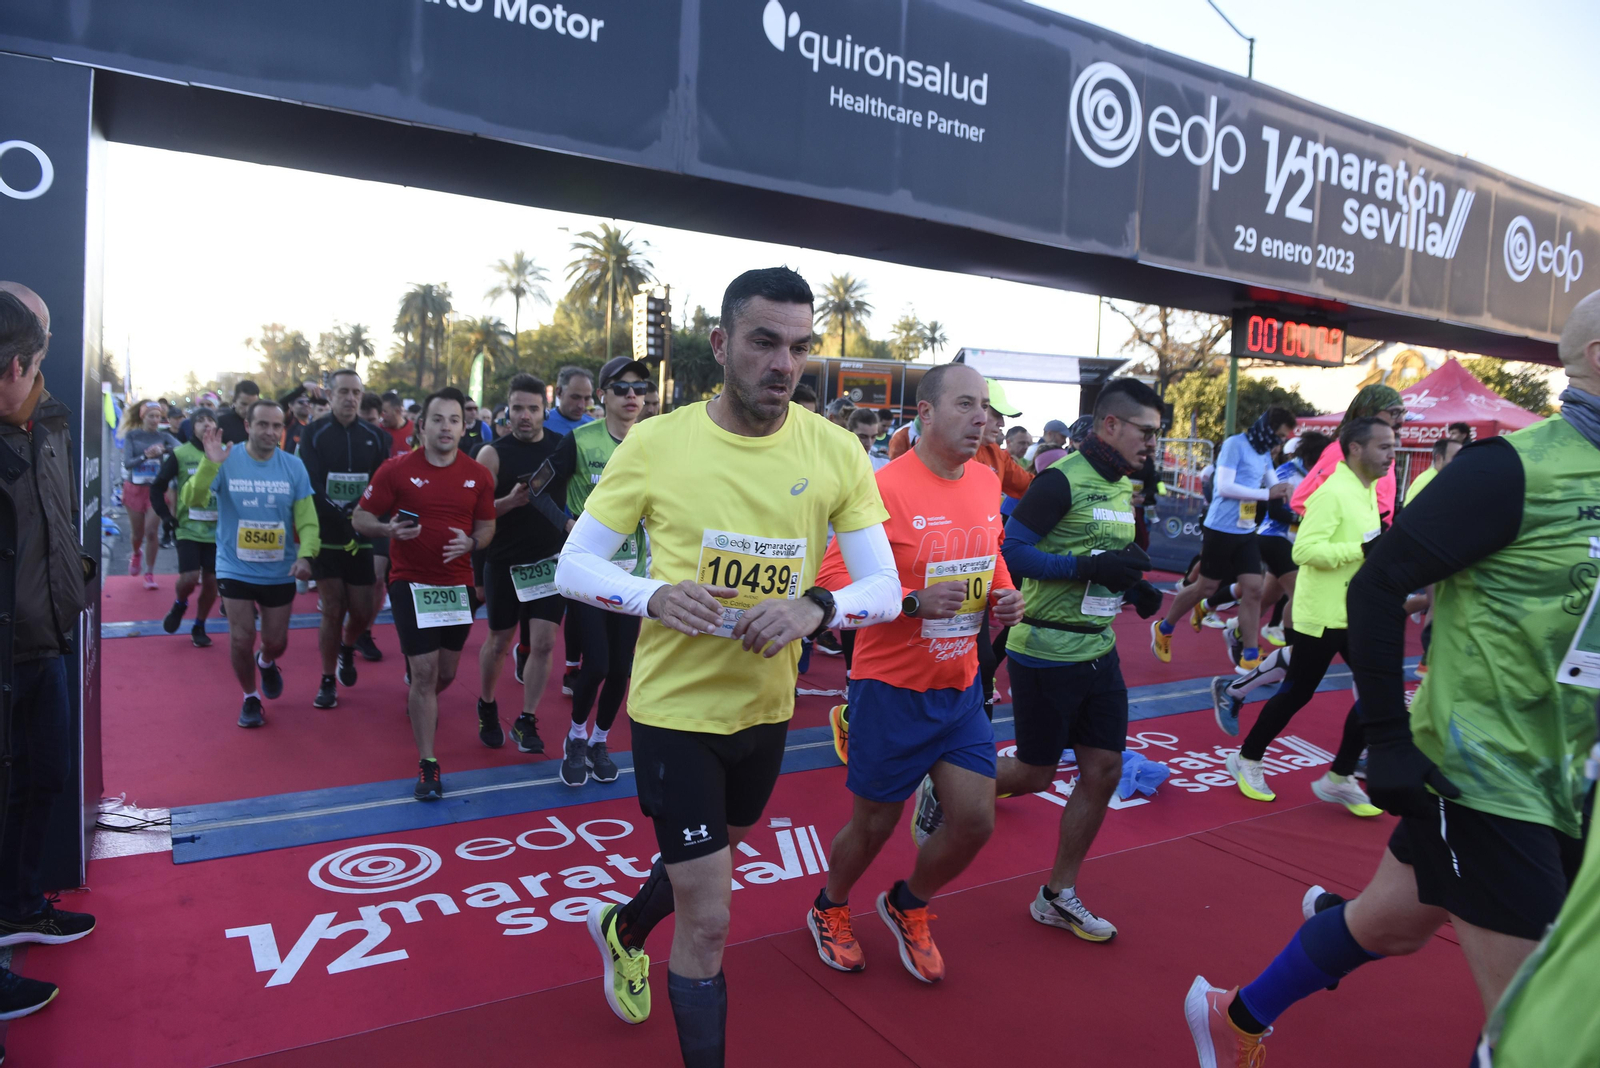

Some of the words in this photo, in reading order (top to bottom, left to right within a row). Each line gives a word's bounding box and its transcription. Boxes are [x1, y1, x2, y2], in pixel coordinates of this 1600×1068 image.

[493, 0, 605, 43] Motor
[799, 30, 989, 106] quirónsalud
[829, 85, 923, 128] Healthcare
[927, 110, 986, 143] Partner
[1147, 94, 1247, 191] edp
[1306, 139, 1447, 218] maratón
[1233, 224, 1258, 254] 29
[1260, 236, 1313, 267] enero
[1316, 243, 1356, 275] 2023
[1341, 197, 1448, 260] sevilla
[1537, 231, 1584, 293] edp
[588, 461, 605, 469] HOK
[333, 483, 361, 496] 5161
[245, 530, 276, 544] 8540
[730, 538, 751, 551] edp
[519, 563, 552, 581] 5293
[708, 556, 791, 595] 10439
[423, 590, 457, 605] 5290
[455, 815, 634, 862] edp
